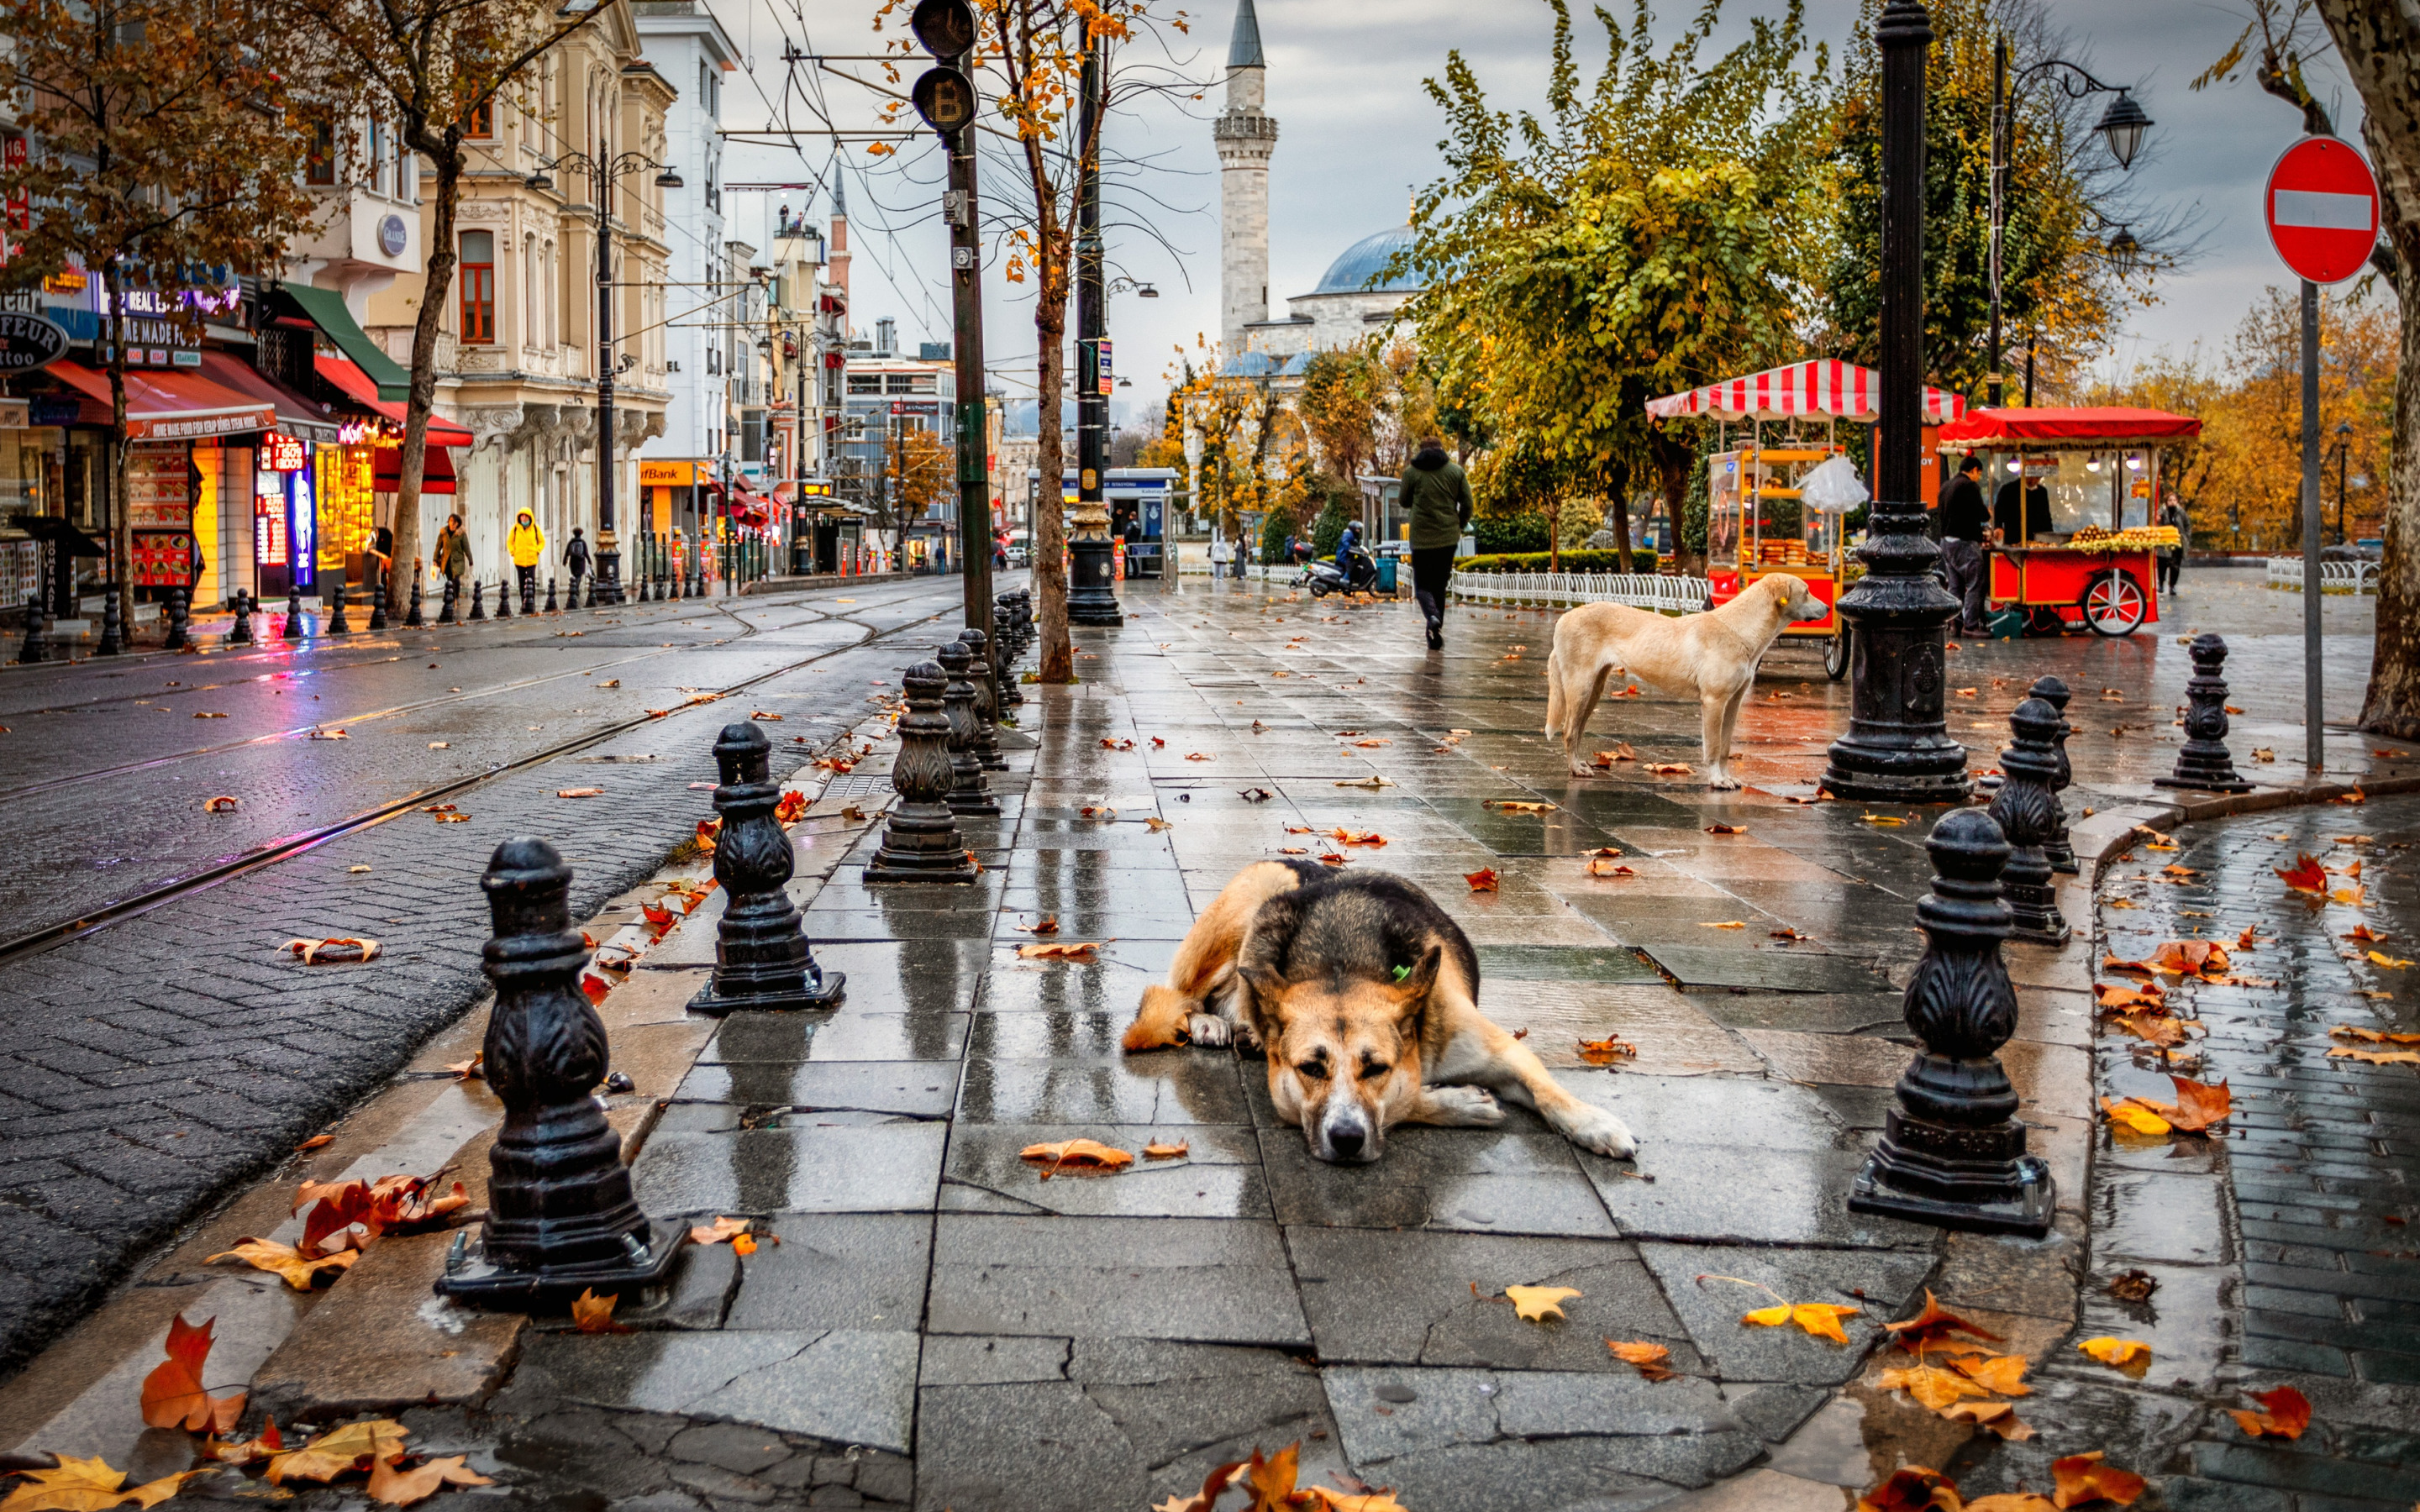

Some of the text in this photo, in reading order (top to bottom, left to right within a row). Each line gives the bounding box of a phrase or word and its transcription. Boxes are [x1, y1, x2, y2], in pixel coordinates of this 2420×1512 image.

[129, 291, 154, 312] REAL
[106, 316, 138, 343] HME
[141, 321, 171, 345] MADE
[666, 360, 681, 372] EL
